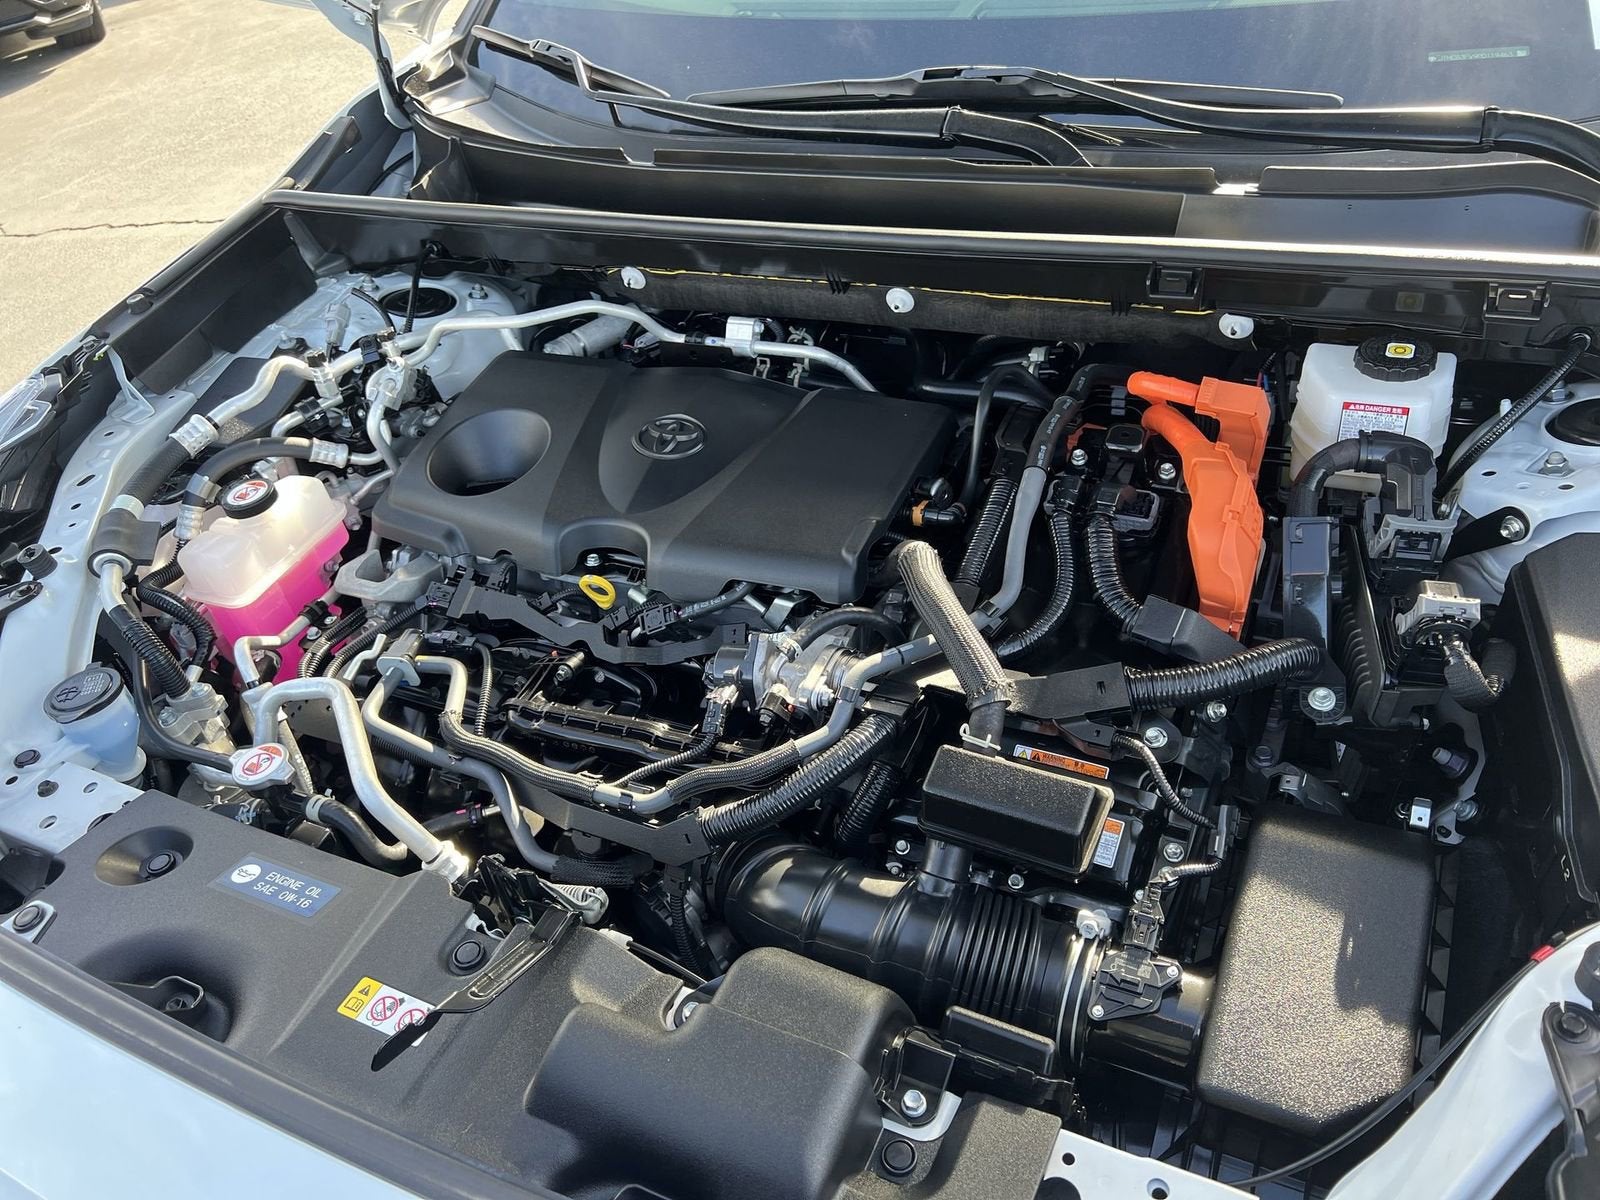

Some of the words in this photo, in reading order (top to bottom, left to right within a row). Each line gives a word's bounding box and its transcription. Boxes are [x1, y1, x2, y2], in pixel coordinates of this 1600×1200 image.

[1365, 405, 1391, 413] DANGER
[253, 882, 278, 895] SAE
[278, 891, 312, 908] 0W-16
[265, 872, 304, 891] ENGINE
[305, 886, 322, 898] OIL
